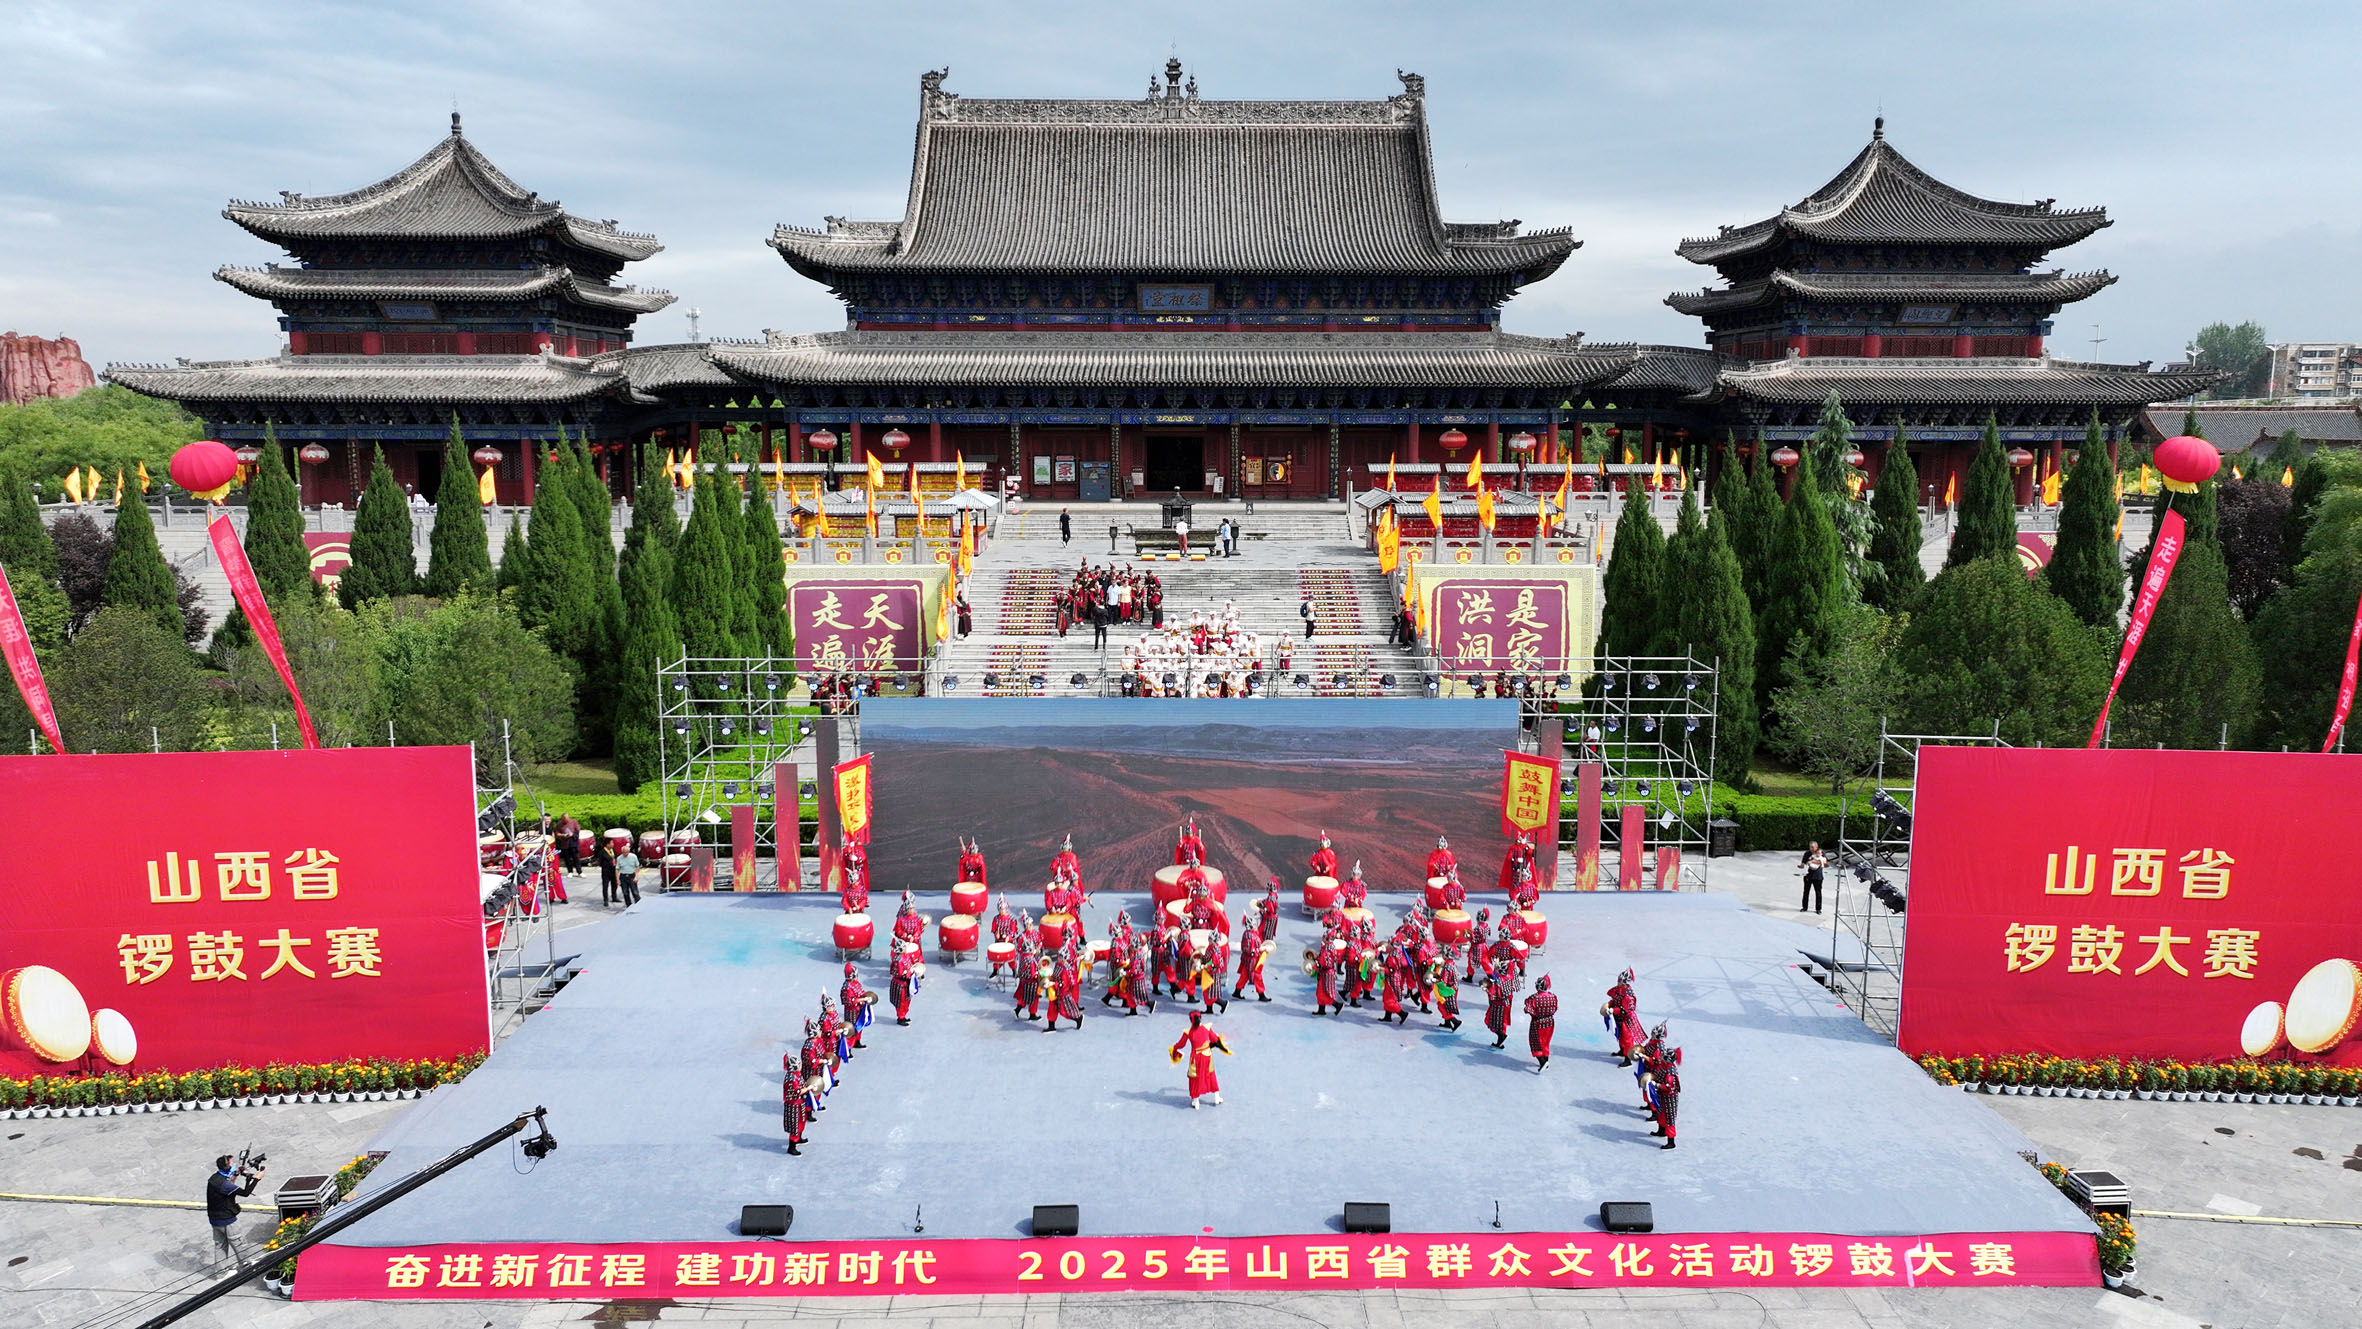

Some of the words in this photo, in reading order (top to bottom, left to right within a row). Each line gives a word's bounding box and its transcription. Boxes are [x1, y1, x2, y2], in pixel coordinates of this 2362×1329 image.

[811, 590, 855, 670] 走遍
[860, 593, 905, 670] 天涯
[1456, 589, 1496, 668] 洪洞
[1505, 588, 1550, 671] 是家
[1516, 769, 1544, 821] 鼓舞中国
[147, 848, 340, 904] 山西省
[2044, 845, 2236, 900] 山西省
[117, 926, 383, 985] 锣鼓大赛
[2004, 922, 2261, 980] 锣鼓大赛
[385, 1253, 646, 1289] 奋进新征程
[675, 1249, 937, 1287] 建功新时代
[1018, 1242, 2017, 1281] 2025年山西省群众文化活动锣鼓大赛
